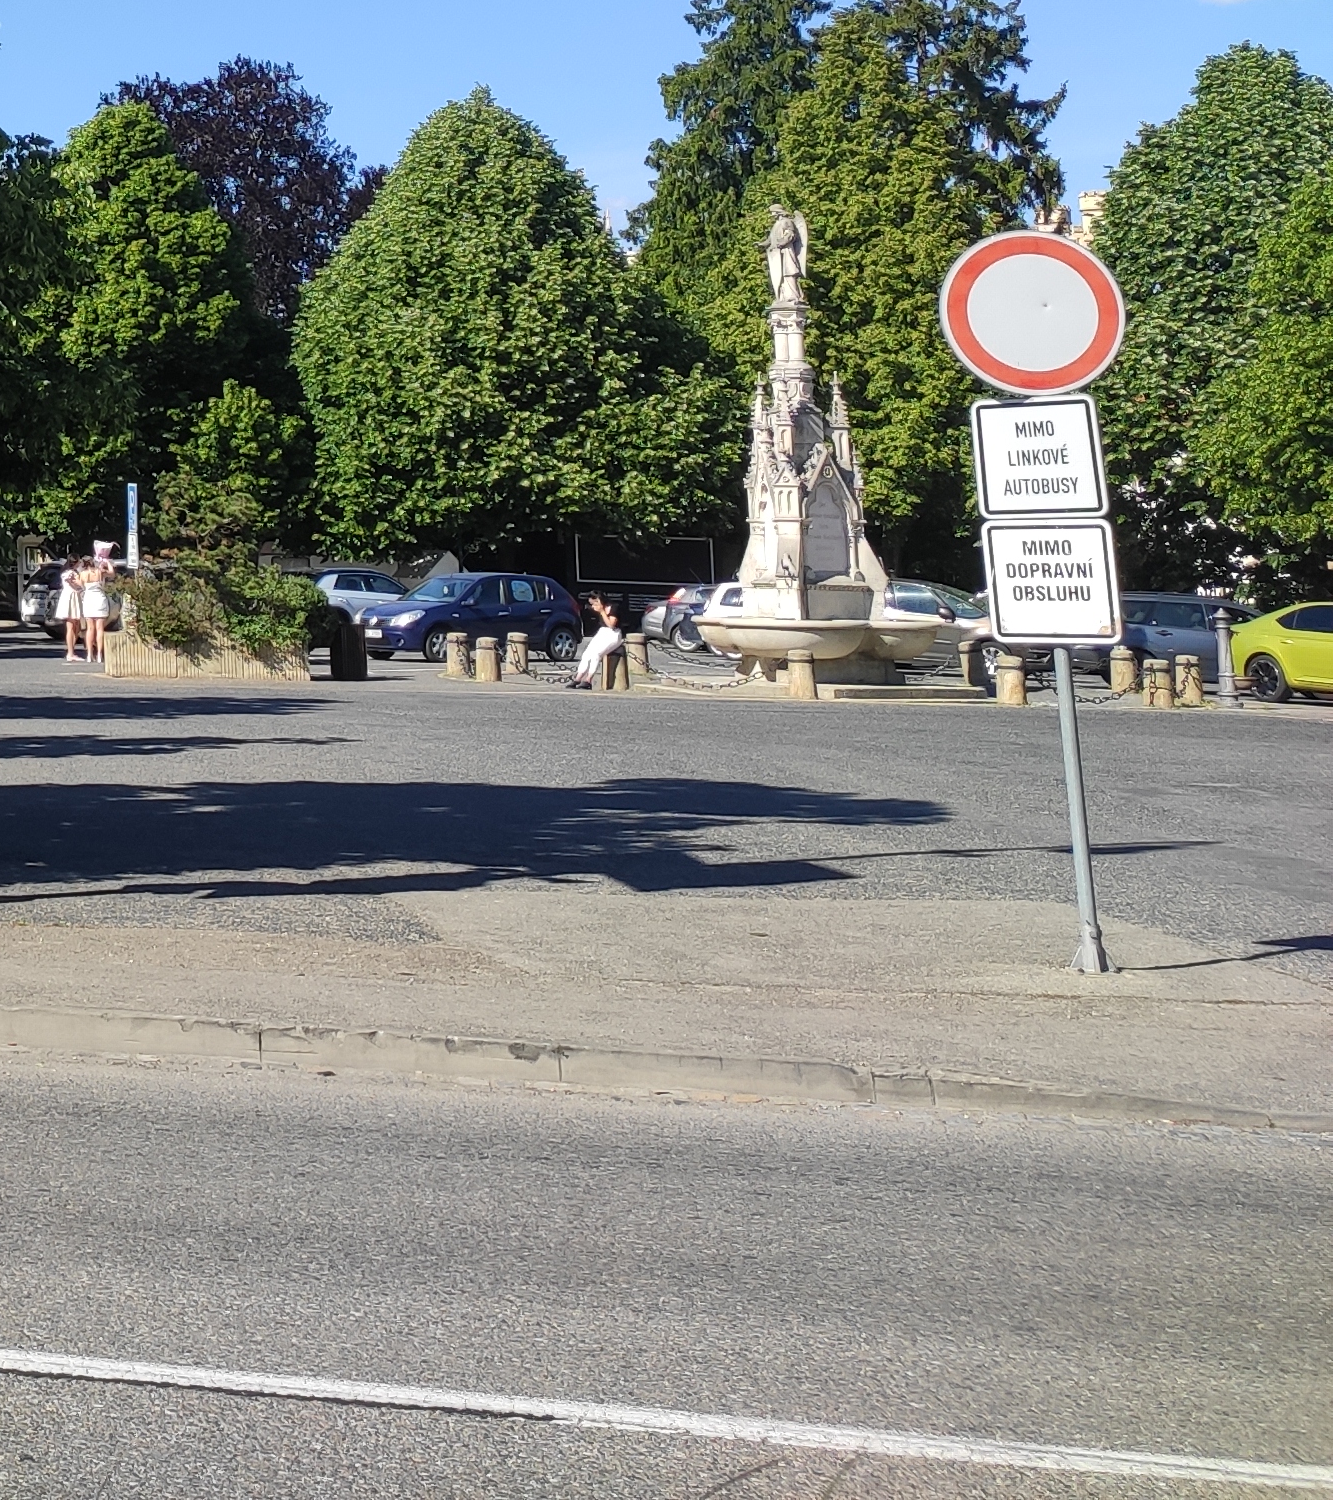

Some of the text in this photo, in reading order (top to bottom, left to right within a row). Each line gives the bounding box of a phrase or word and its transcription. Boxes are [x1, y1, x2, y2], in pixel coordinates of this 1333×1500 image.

[1015, 420, 1055, 438] MIMO
[1008, 443, 1070, 467] LINKOVÉ
[1004, 476, 1078, 496] AUTOBUSY
[1022, 539, 1072, 556] MIMO
[1006, 557, 1093, 579] DOPRAVNÍ
[1012, 585, 1091, 602] OBSLUHU
